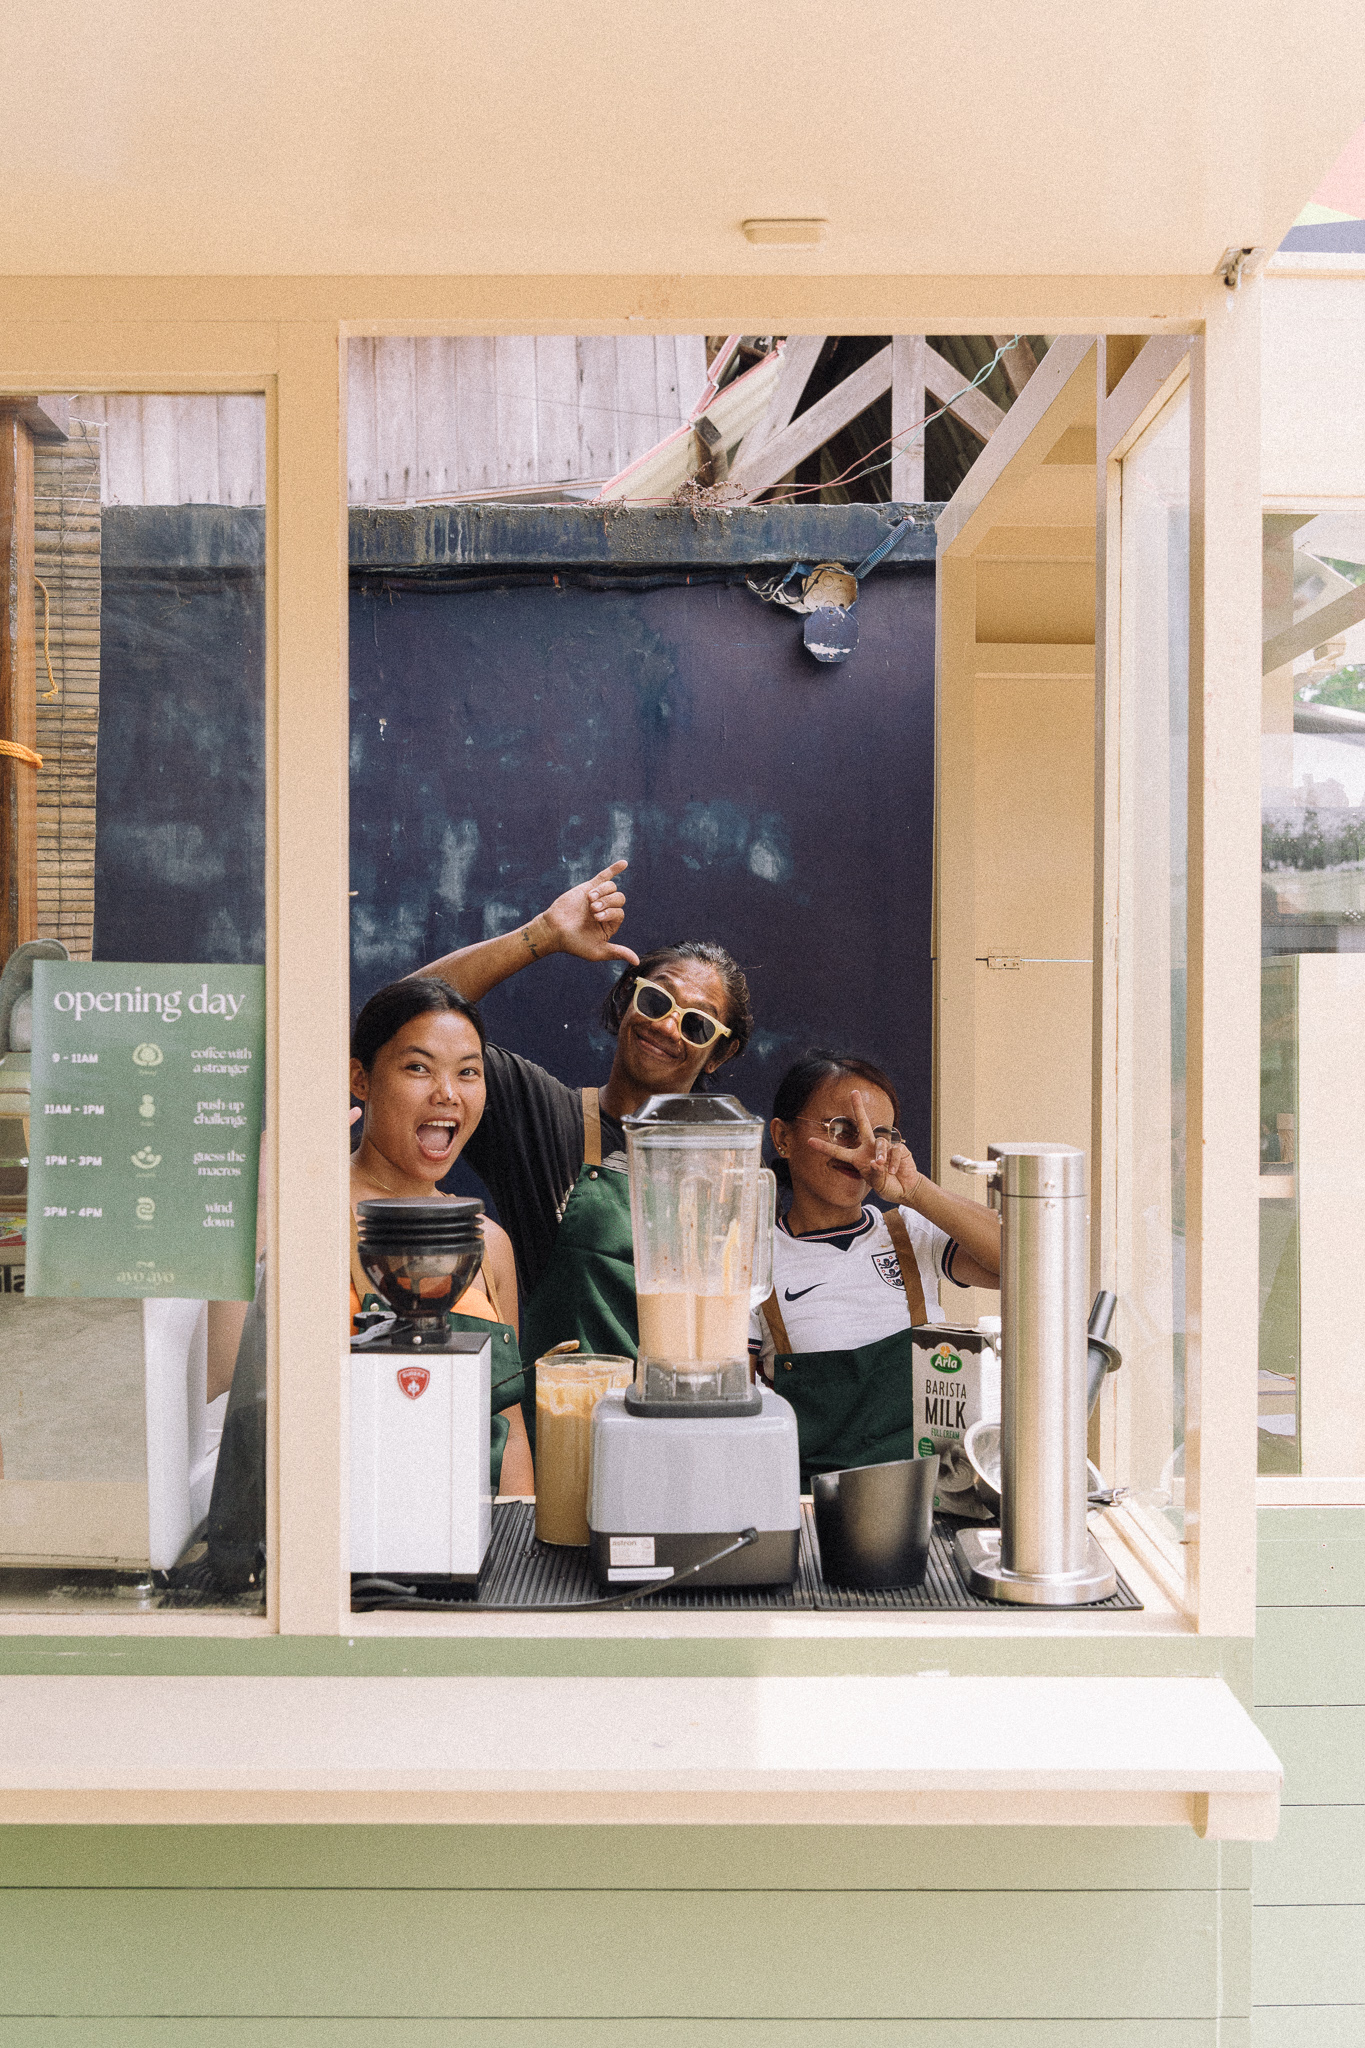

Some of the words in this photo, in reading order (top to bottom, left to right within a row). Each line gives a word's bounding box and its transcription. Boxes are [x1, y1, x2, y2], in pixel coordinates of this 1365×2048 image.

[53, 986, 183, 1023] opening
[187, 983, 246, 1021] day
[71, 1053, 98, 1064] 11AM
[190, 1046, 227, 1059] coffee
[228, 1047, 253, 1060] with
[193, 1064, 201, 1073] a
[202, 1063, 250, 1077] stranger
[44, 1104, 72, 1115] 11AM
[82, 1104, 105, 1115] 1PM
[196, 1098, 226, 1113] push
[228, 1101, 245, 1114] up
[193, 1112, 248, 1129] challenge
[45, 1155, 67, 1166] 1PM
[78, 1156, 102, 1166] 3PM
[192, 1152, 225, 1165] guess
[226, 1150, 247, 1162] the
[197, 1166, 242, 1177] macros
[43, 1206, 68, 1217] 3PM
[78, 1207, 102, 1217] 4PM
[205, 1201, 233, 1213] wind
[202, 1215, 235, 1228] down
[117, 1271, 145, 1285] ayo
[146, 1271, 175, 1286] ayo
[934, 1355, 958, 1369] Arla
[925, 1379, 967, 1400] BARISTA
[925, 1396, 967, 1430] MILK
[931, 1427, 942, 1438] FULL
[943, 1430, 960, 1440] CREAM
